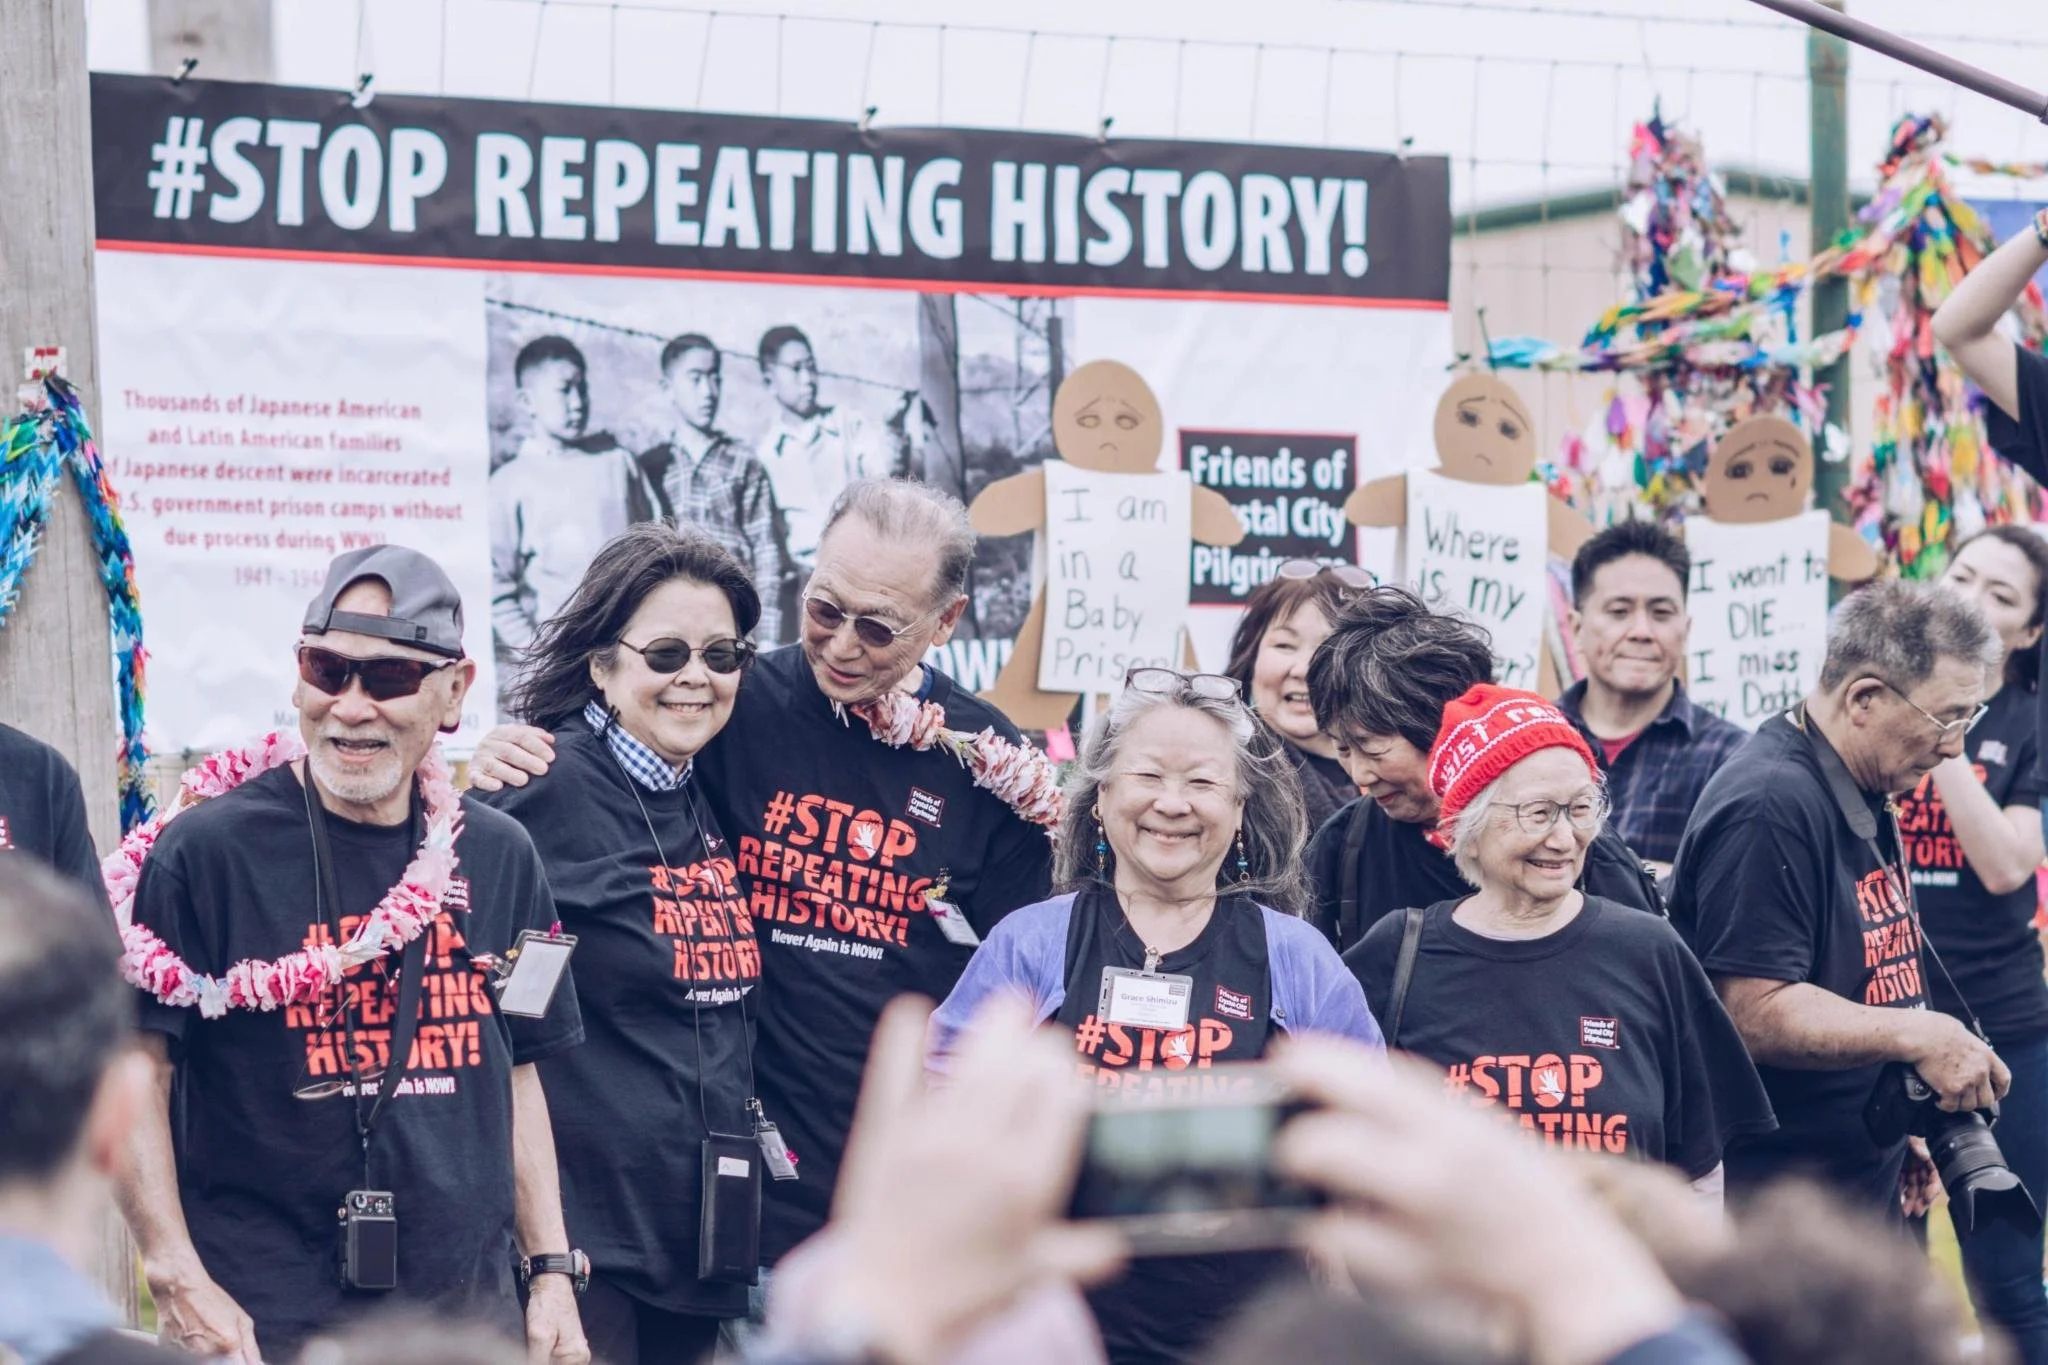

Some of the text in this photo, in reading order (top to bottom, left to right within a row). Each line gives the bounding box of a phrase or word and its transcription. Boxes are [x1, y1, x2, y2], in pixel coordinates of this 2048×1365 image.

[148, 115, 1368, 278] #STOP REPEATING HISTORY!
[124, 389, 422, 419] Thousands of Japanese American
[148, 425, 403, 452] and Latin American families
[124, 456, 209, 483] Japanese
[215, 460, 284, 481] descent
[291, 467, 333, 483] were
[338, 463, 451, 487] incarcerated
[1190, 444, 1348, 490] Friends of
[152, 495, 265, 518] government
[270, 496, 325, 519] prison
[330, 502, 387, 521] camps
[392, 500, 463, 520] without
[1061, 488, 1168, 523] I am
[1231, 495, 1346, 548] stal City
[164, 527, 198, 546] due
[203, 531, 270, 550] process
[275, 529, 336, 554] during
[1424, 505, 1520, 562] Where
[1057, 539, 1140, 582] in a
[1691, 550, 1828, 593] I want to
[1420, 559, 1526, 622] is my
[1064, 588, 1144, 644] Baby
[1728, 599, 1777, 640] DIE
[1694, 646, 1800, 683] I miss
[763, 790, 918, 868] #STOP
[737, 835, 934, 913] REPEATING
[751, 880, 909, 948] HISTORY!
[771, 928, 885, 960] Never Again is NOW!
[1120, 993, 1145, 1003] Grace
[424, 1076, 456, 1094] NOW!
